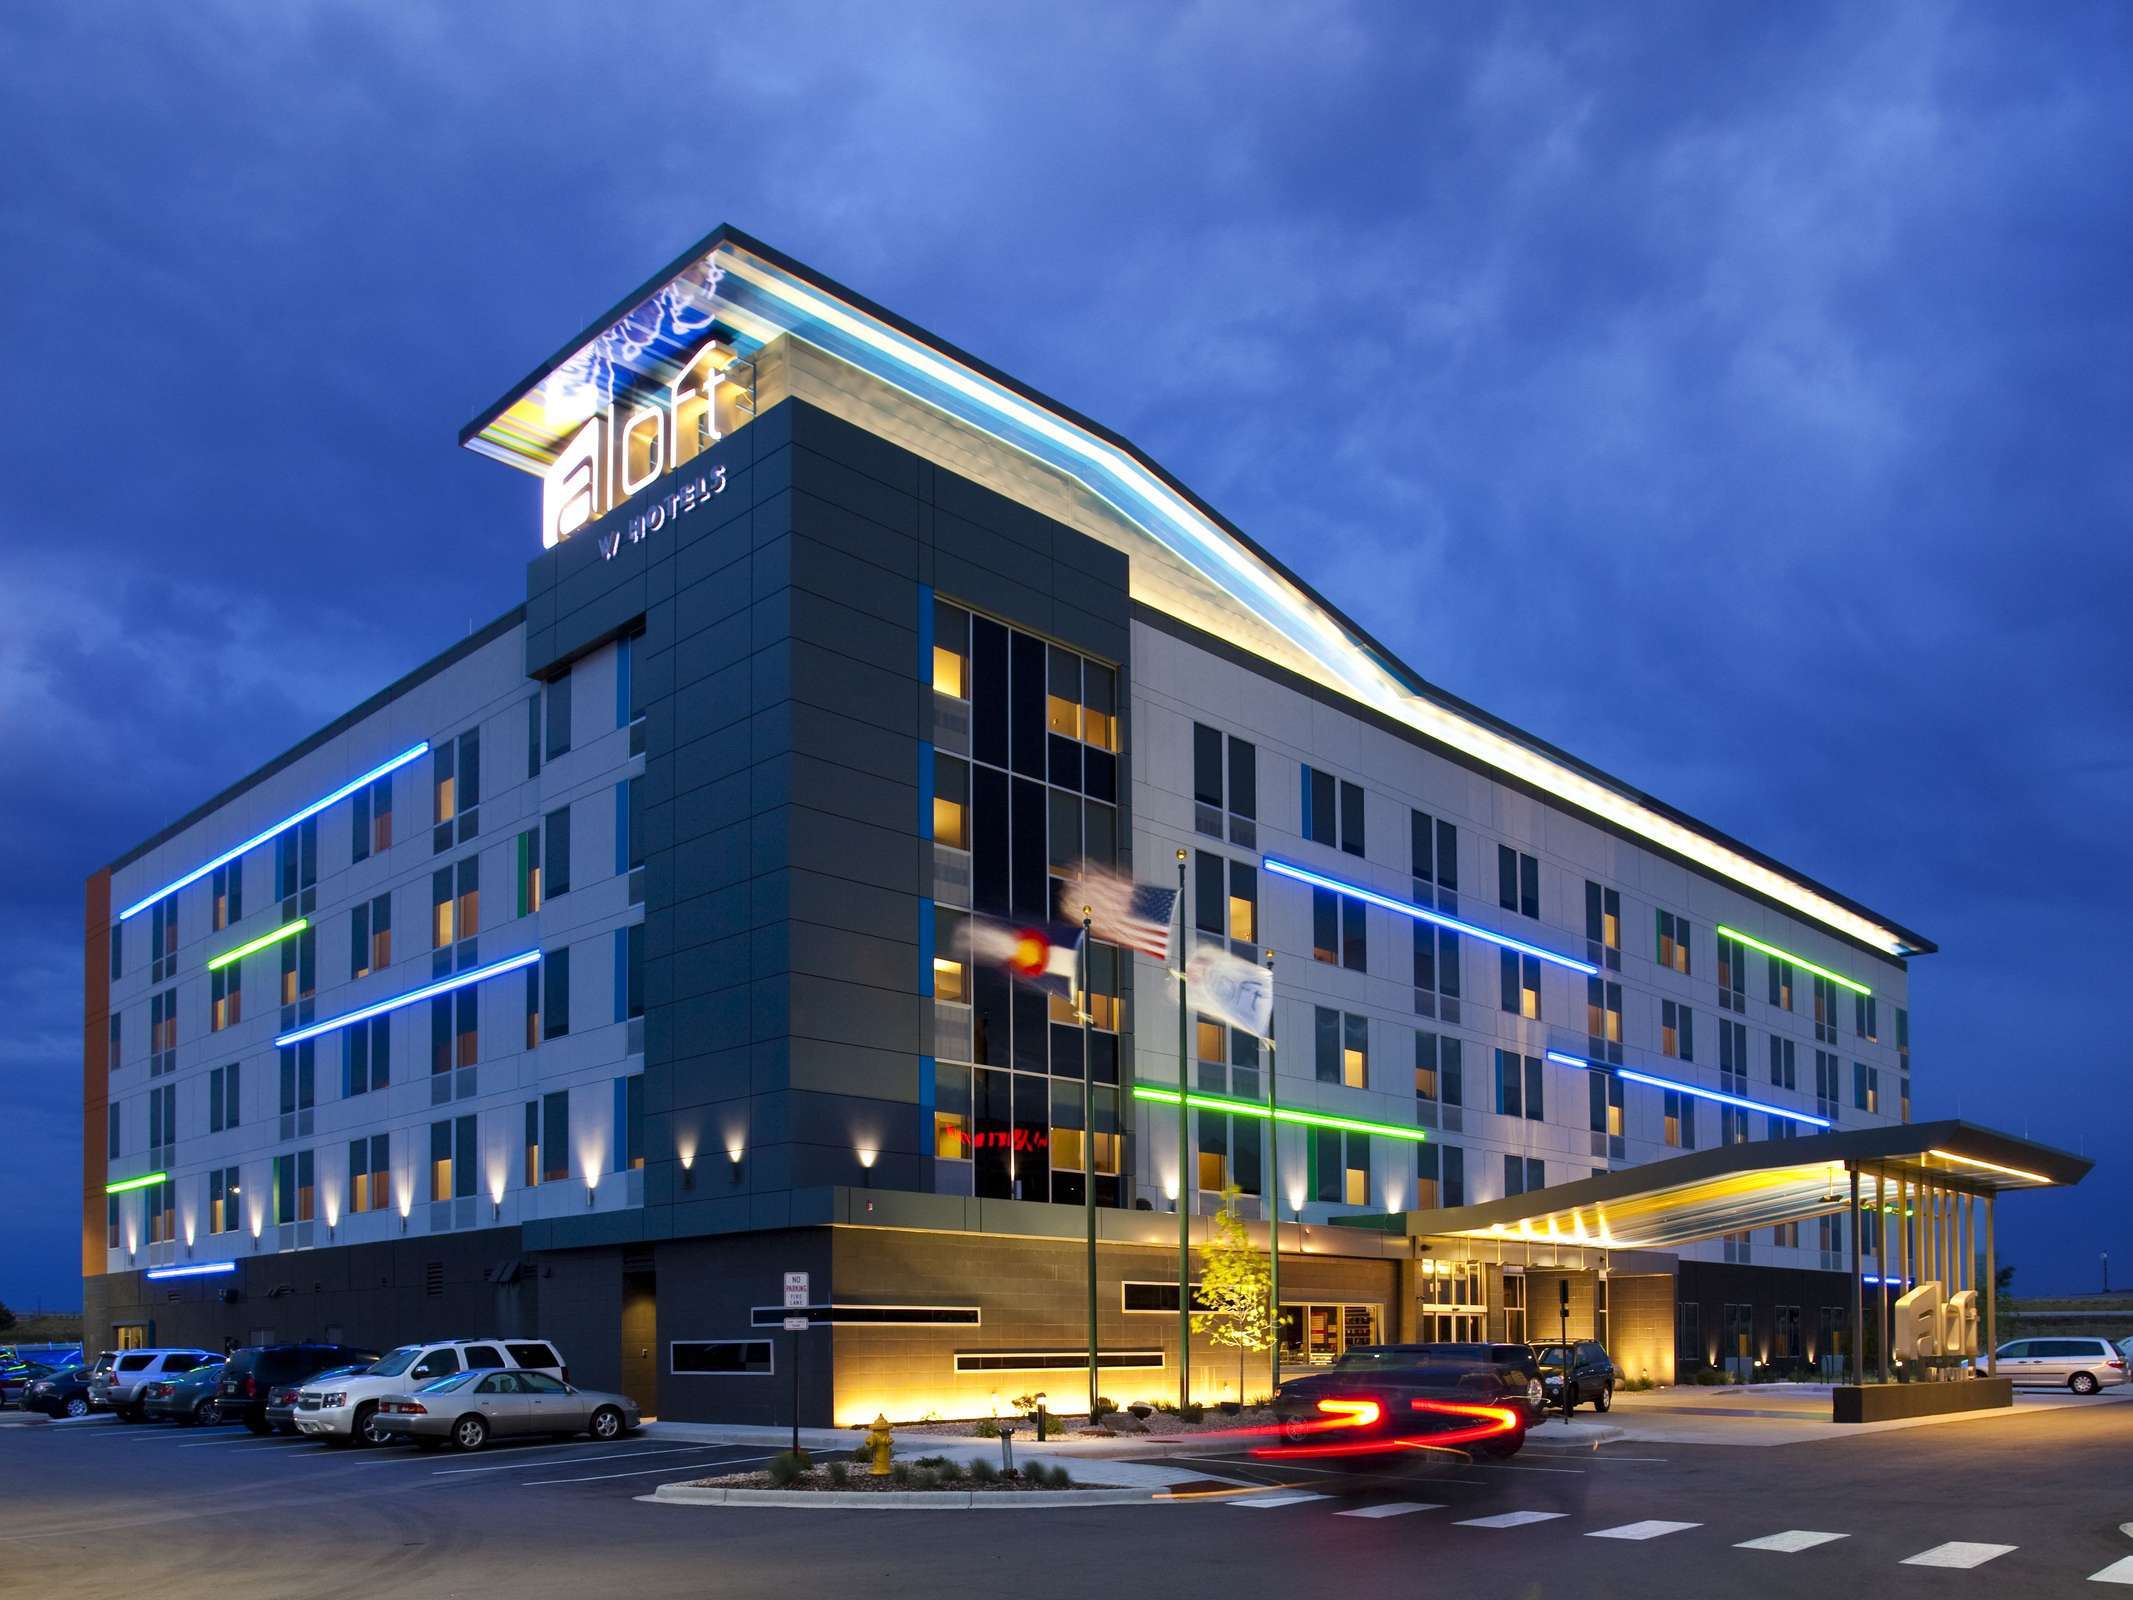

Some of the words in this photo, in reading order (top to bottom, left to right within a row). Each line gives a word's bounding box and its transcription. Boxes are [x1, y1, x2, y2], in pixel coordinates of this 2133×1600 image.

[543, 340, 726, 549] aloft
[629, 464, 727, 543] HOTELS
[784, 1284, 808, 1292] PARKING
[792, 1275, 801, 1284] NO
